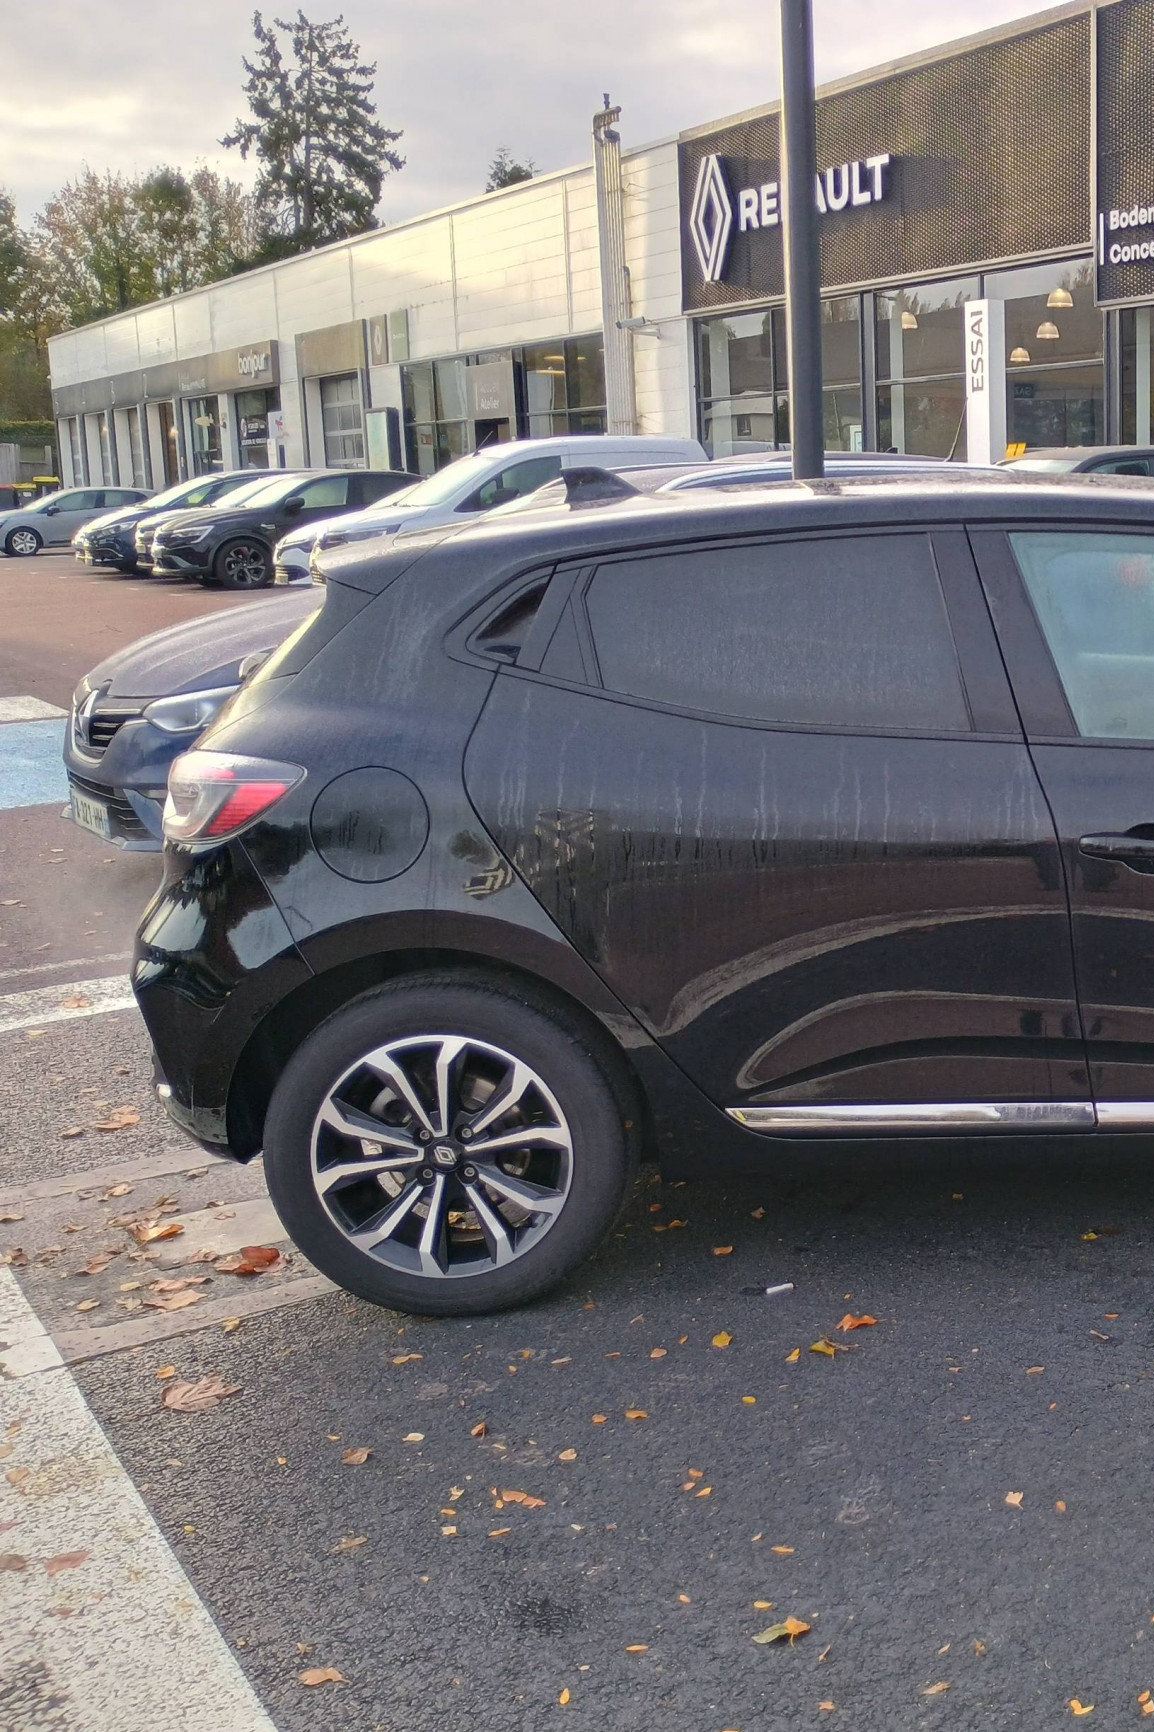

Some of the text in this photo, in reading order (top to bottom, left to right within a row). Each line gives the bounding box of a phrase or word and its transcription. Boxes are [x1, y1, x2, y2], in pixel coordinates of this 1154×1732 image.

[739, 153, 889, 232] REULT
[237, 349, 266, 379] bonjour
[970, 310, 984, 393] ESSAI
